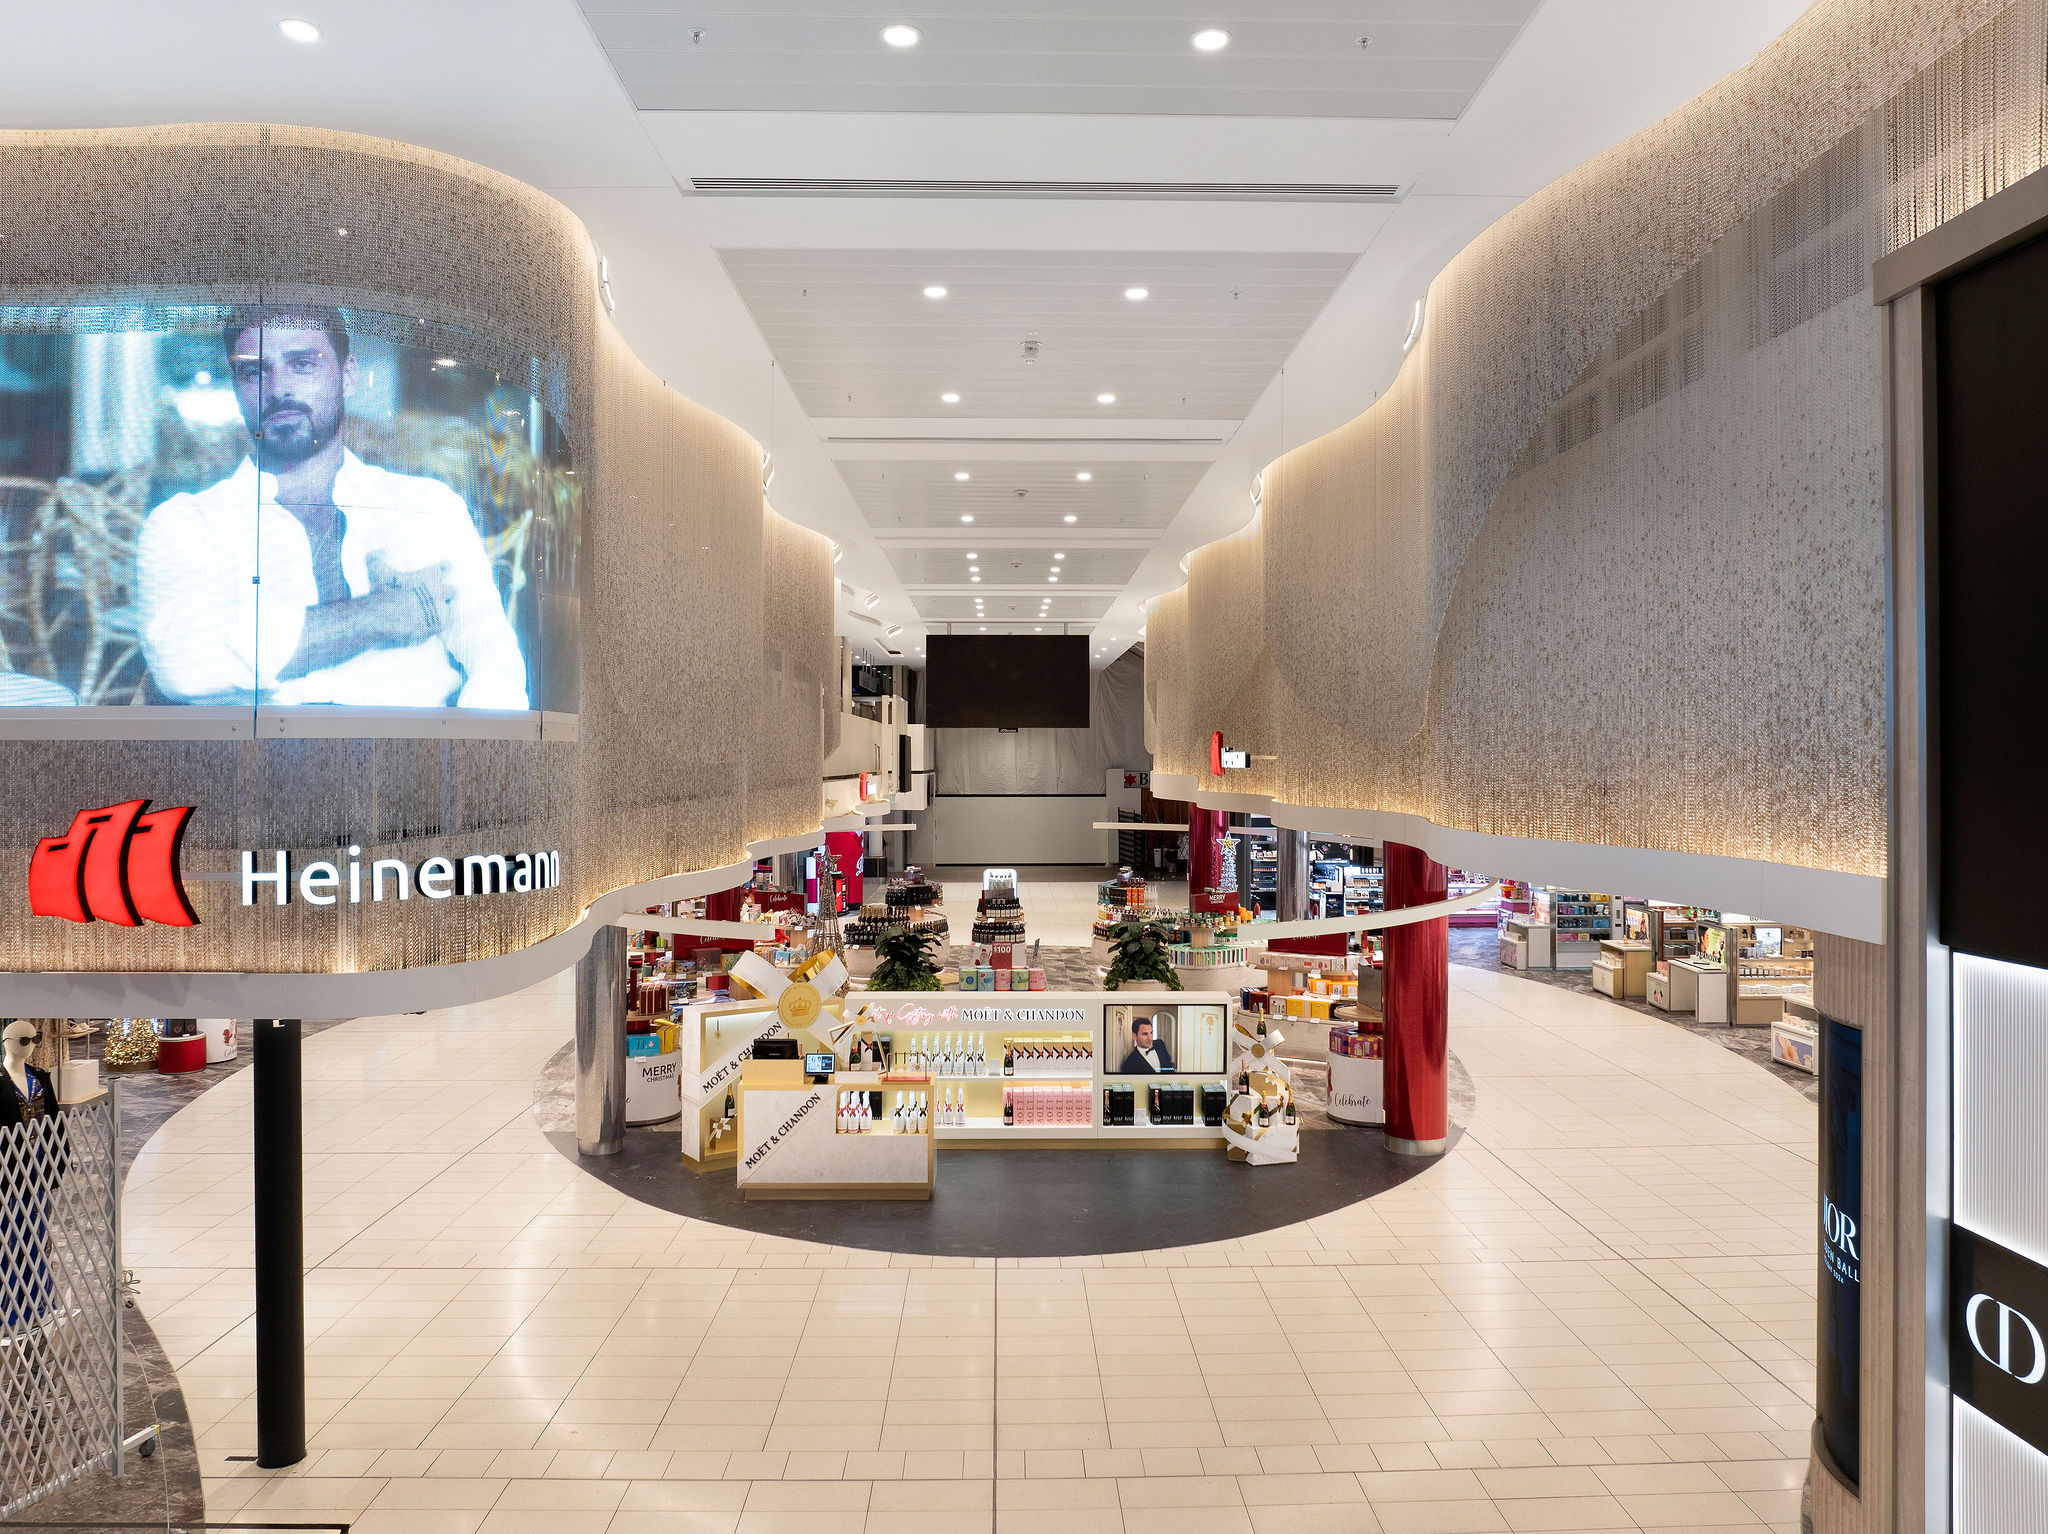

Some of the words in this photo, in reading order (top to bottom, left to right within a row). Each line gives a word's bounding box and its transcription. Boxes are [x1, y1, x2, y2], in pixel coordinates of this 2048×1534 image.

[242, 845, 560, 906] Heinemann
[1209, 893, 1226, 901] MERRY
[993, 946, 1011, 954] $100
[961, 1006, 1000, 1021] MOËT
[1003, 1009, 1013, 1021] &
[1016, 1008, 1086, 1021] CHANDON
[642, 1062, 677, 1077] MERRY
[702, 1066, 730, 1093] MOËT
[729, 1060, 739, 1070] &
[646, 1073, 674, 1082] CHRISTMAS
[1334, 1093, 1370, 1107] Celebrate
[745, 1141, 771, 1169] MOËT
[770, 1135, 780, 1144] &
[778, 1092, 821, 1137] CHANDON
[1824, 1192, 1860, 1261] IOR
[1837, 1257, 1860, 1283] BALL
